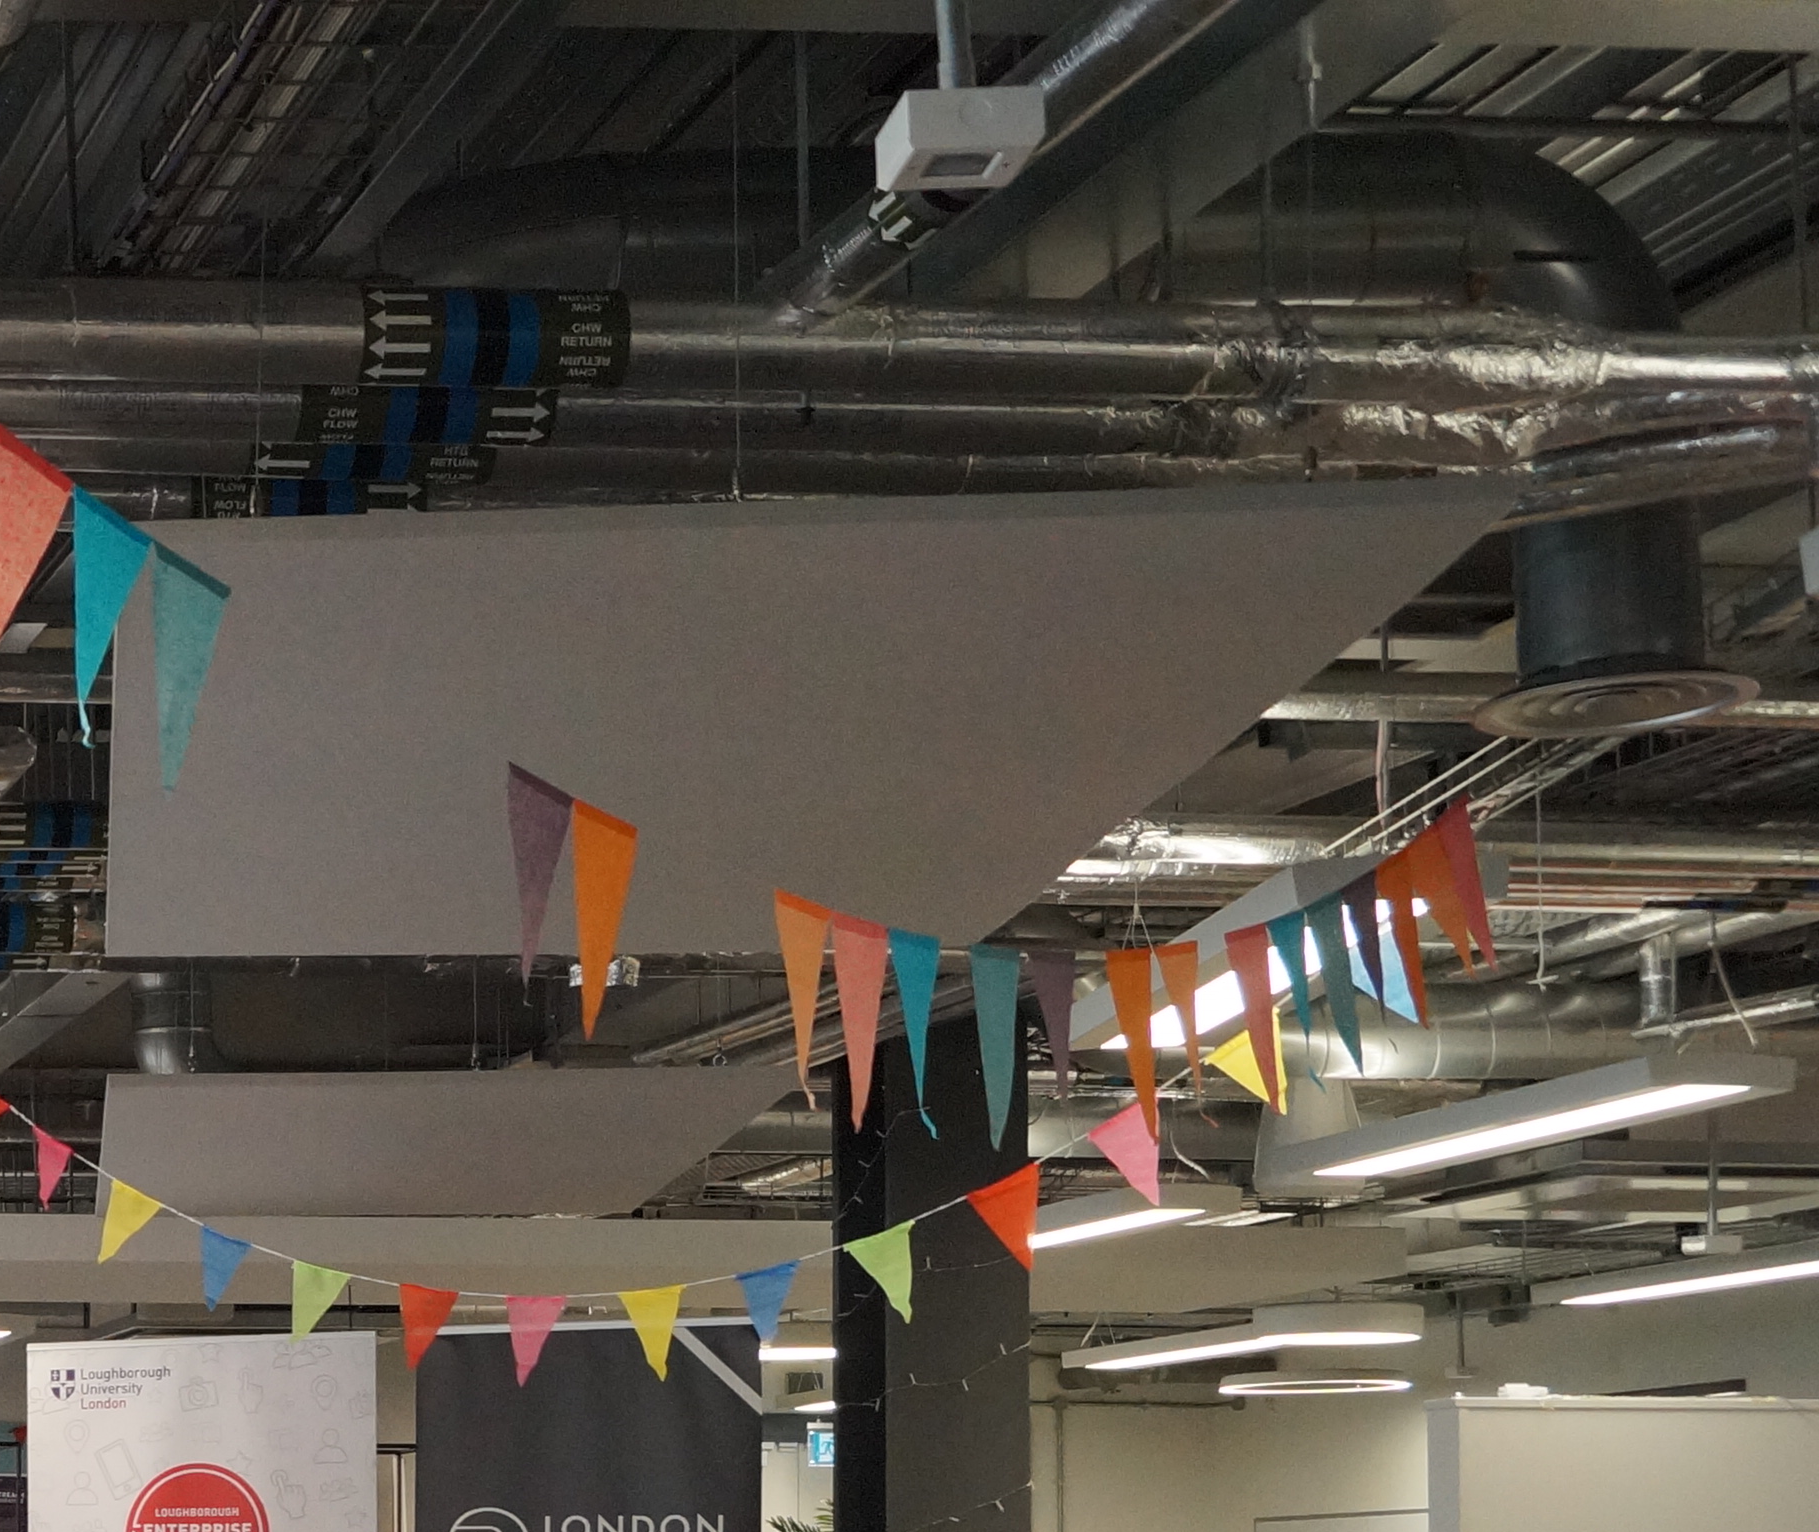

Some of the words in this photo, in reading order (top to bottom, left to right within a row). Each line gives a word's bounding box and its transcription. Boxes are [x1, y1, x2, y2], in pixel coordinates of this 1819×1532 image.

[571, 323, 602, 333] CHW
[560, 336, 612, 348] RETURN
[327, 408, 358, 419] CHW
[322, 419, 358, 430] FLOW
[429, 457, 479, 468] RETURN
[80, 1366, 171, 1382] Loughborough
[80, 1382, 143, 1396] University
[80, 1397, 127, 1410] London
[154, 1507, 240, 1518] LOUGHBOROUGH
